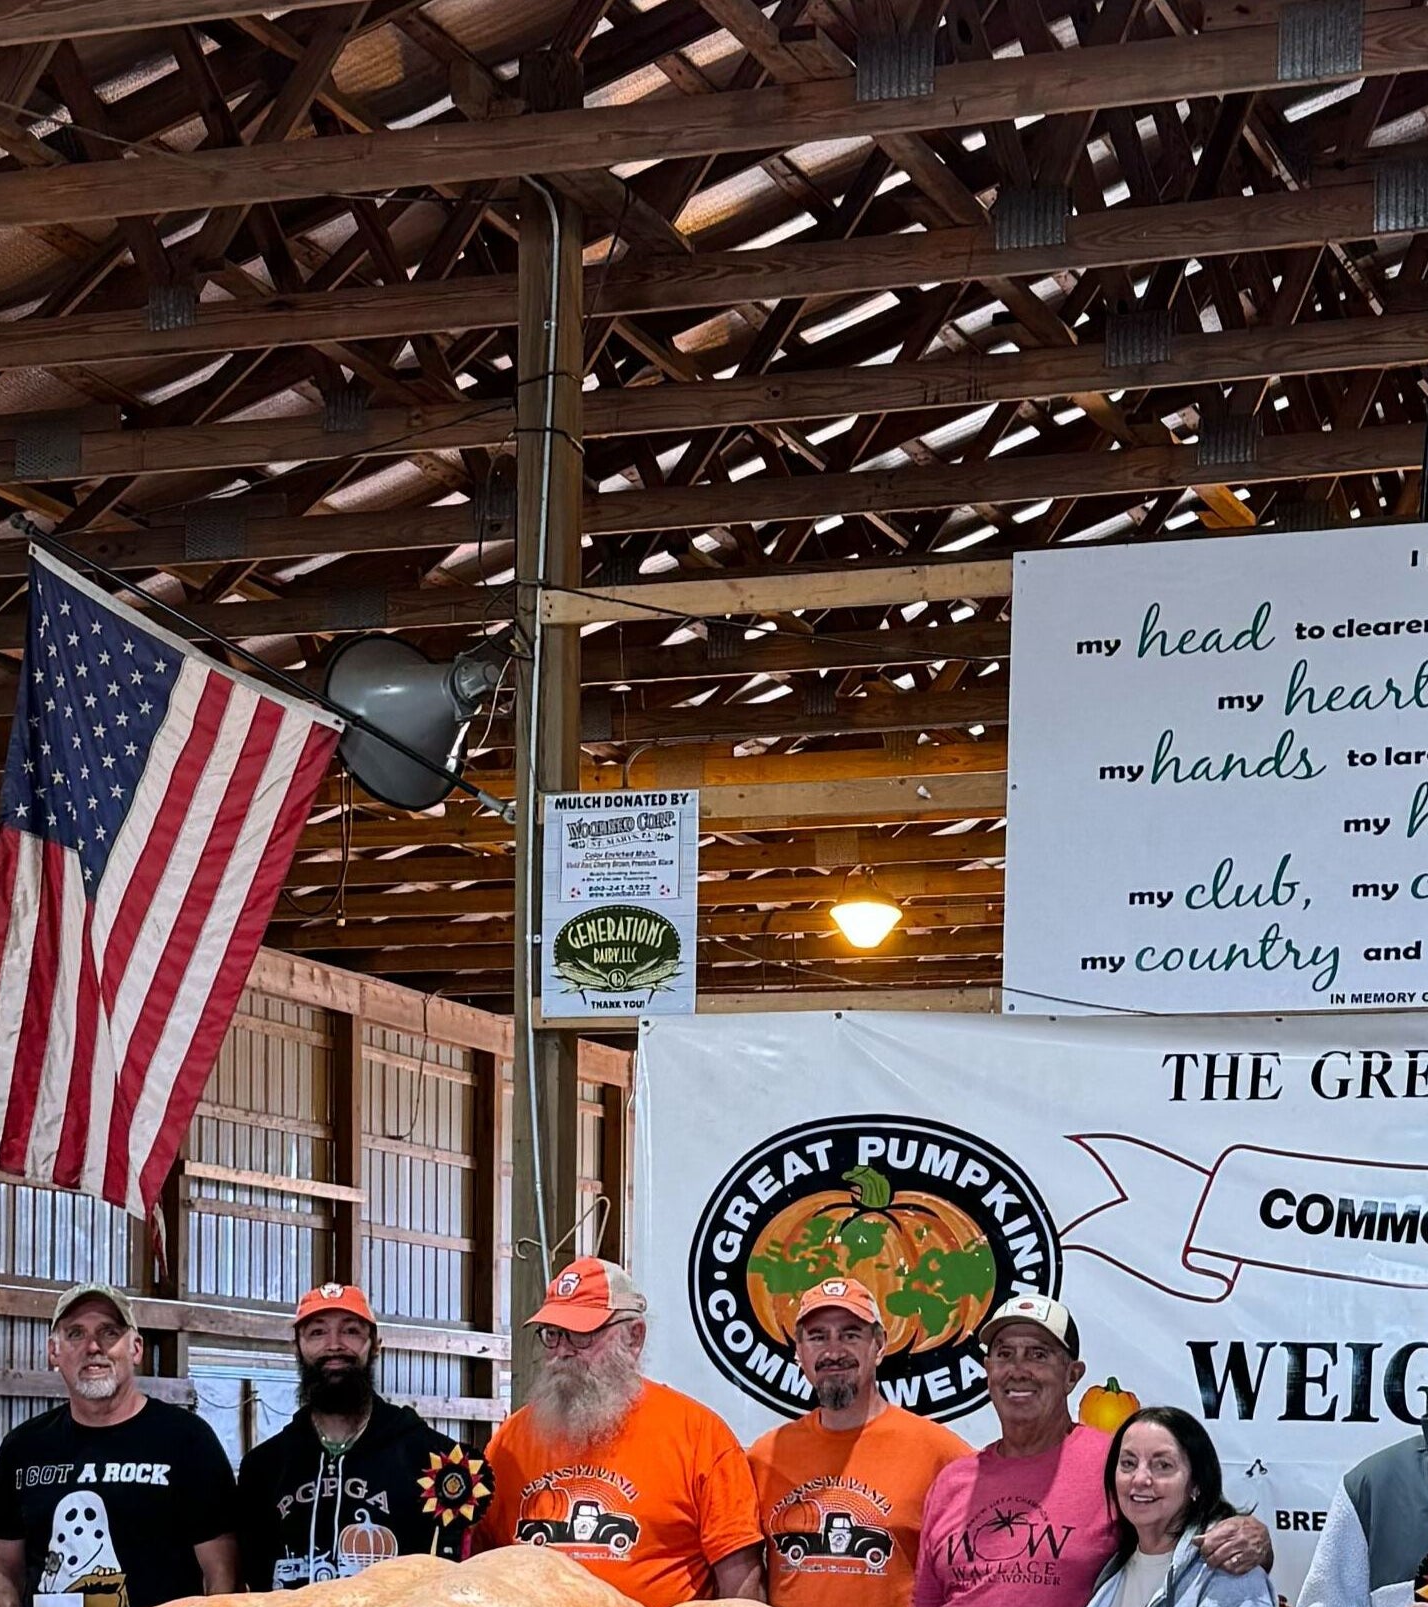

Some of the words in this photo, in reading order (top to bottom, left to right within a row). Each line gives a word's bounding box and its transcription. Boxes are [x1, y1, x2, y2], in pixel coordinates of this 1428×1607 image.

[1410, 549, 1419, 567] I
[1076, 636, 1121, 657] my
[1138, 602, 1275, 657] head
[1295, 621, 1326, 641] to
[1218, 693, 1263, 713] my
[1099, 765, 1144, 783] my
[1151, 729, 1326, 784] hands
[1347, 748, 1377, 767] to
[555, 795, 601, 809] MULCH
[605, 794, 667, 808] DONATED
[671, 793, 689, 805] BY
[1344, 816, 1390, 835] my
[1129, 889, 1173, 908] my
[1185, 854, 1311, 910] club,
[1352, 881, 1398, 900] my
[568, 916, 667, 948] GENERATIONS
[1081, 954, 1125, 972] my
[1135, 923, 1339, 992] country
[1363, 941, 1421, 960] and
[592, 1001, 621, 1009] THANK
[624, 1000, 645, 1008] YOU!
[1330, 993, 1345, 1005] IN
[1351, 991, 1416, 1003] MEMORY
[1162, 1052, 1283, 1101] THE
[713, 1138, 833, 1263] GREAT
[858, 1136, 1044, 1272] PUMPKIN
[15, 1468, 24, 1490] I
[26, 1464, 74, 1487] GOT
[77, 1462, 96, 1484] A
[103, 1462, 171, 1486] ROCK
